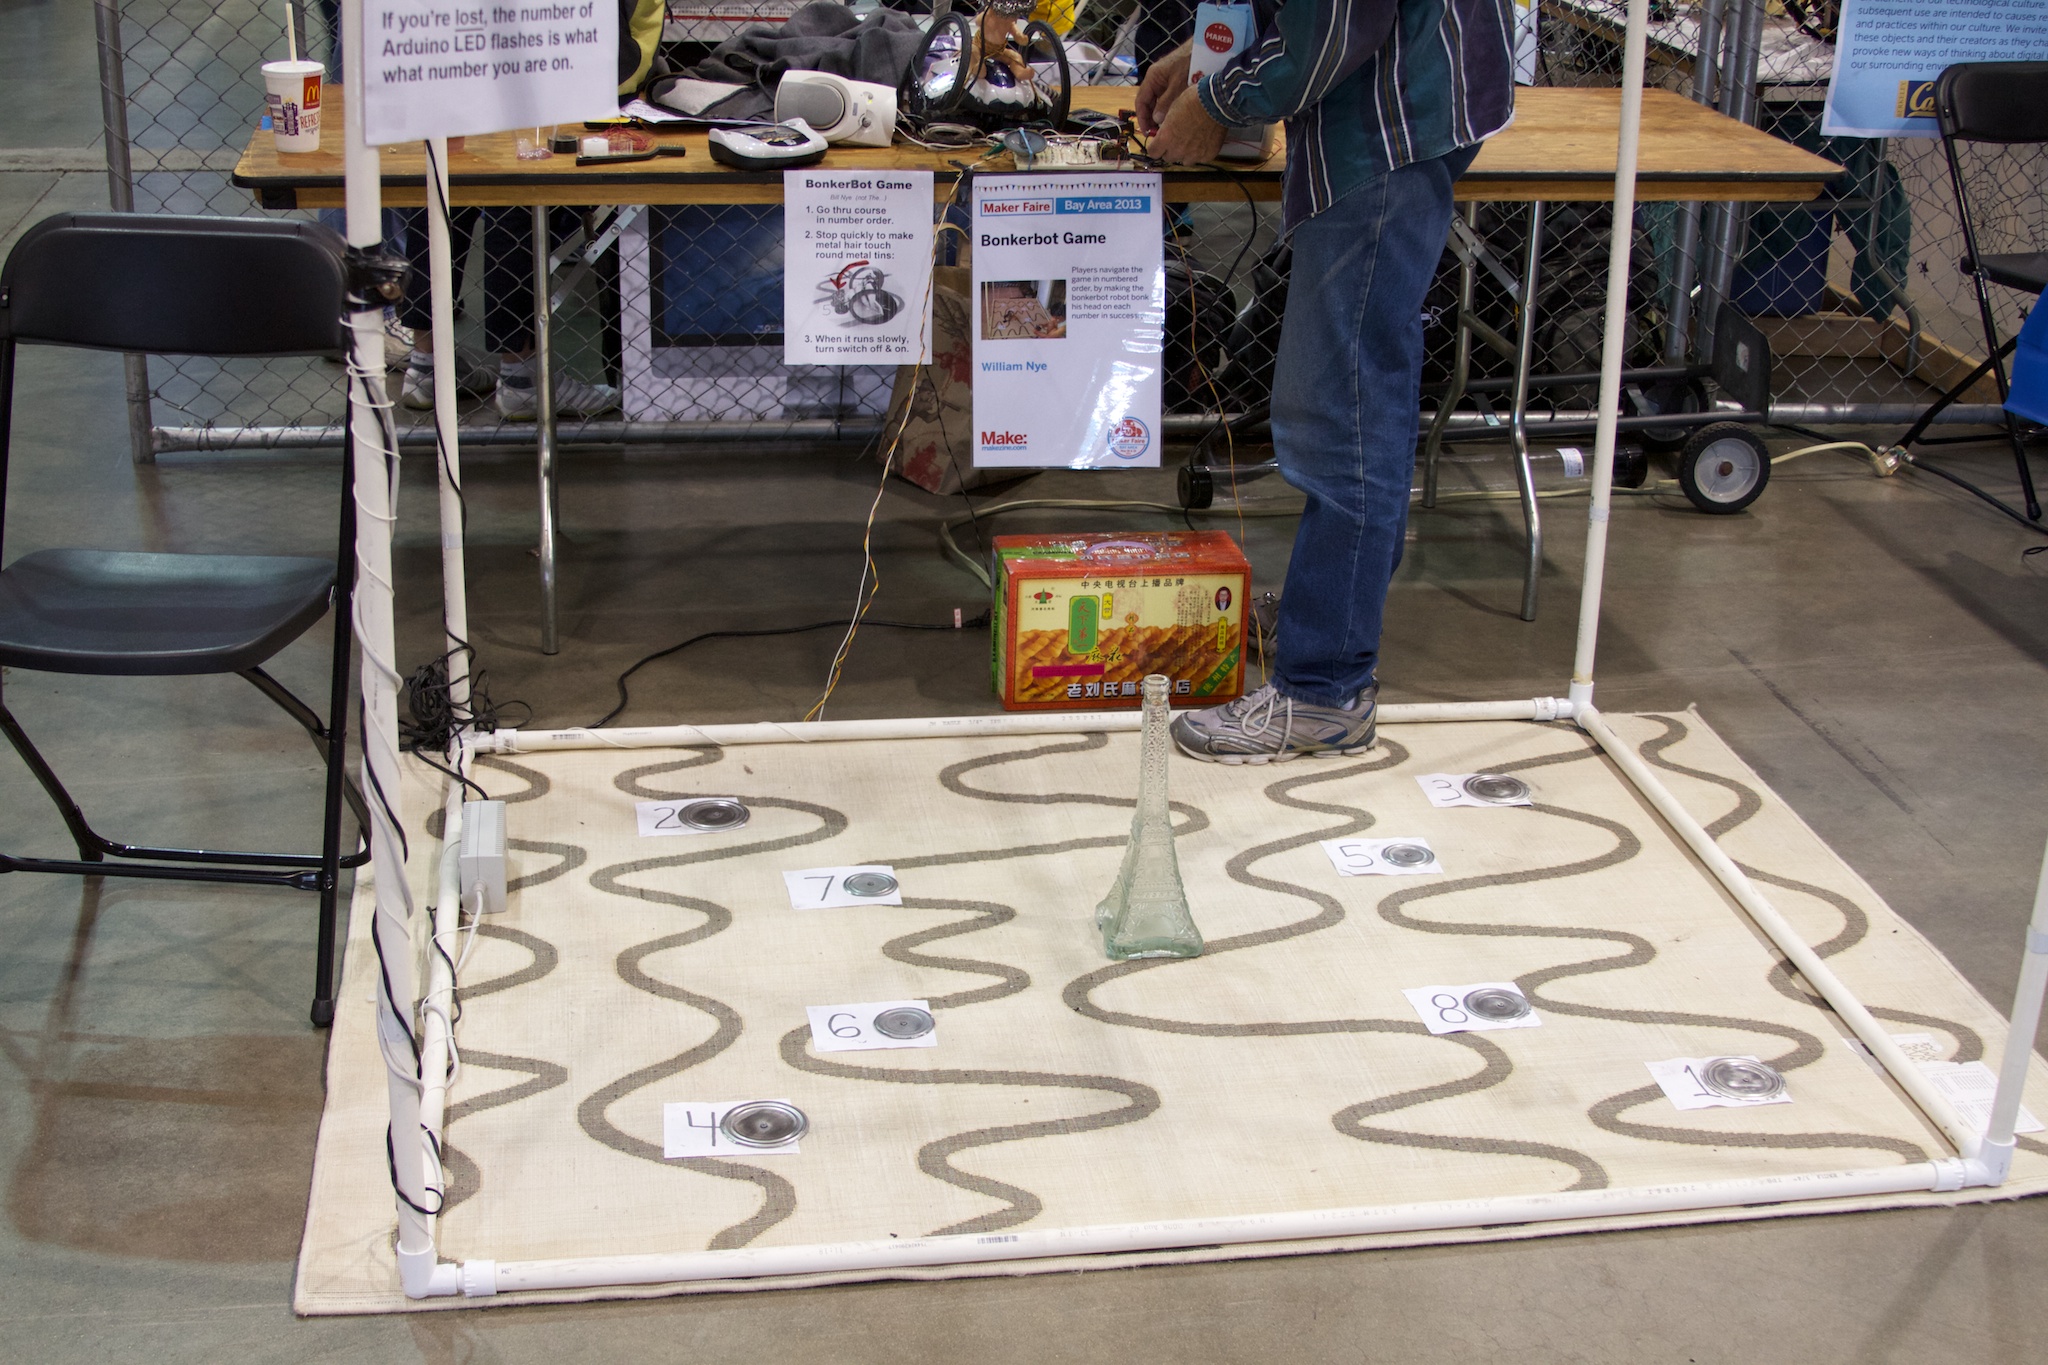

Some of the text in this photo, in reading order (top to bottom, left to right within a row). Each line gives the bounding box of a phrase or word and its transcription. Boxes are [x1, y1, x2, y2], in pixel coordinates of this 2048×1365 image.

[382, 2, 594, 34] If you're lost, the number of
[1858, 7, 1912, 17] subsequent
[1914, 9, 1930, 17] use
[1932, 10, 1947, 18] are
[1950, 9, 1990, 19] intended
[1993, 11, 2003, 20] to
[2005, 13, 2036, 21] causes
[1855, 20, 1873, 29] and
[1875, 20, 1917, 31] practices
[1920, 21, 1948, 31] within
[2006, 24, 2020, 33] We
[2022, 25, 2047, 34] invite
[382, 28, 598, 57] Arduino LED flashes is what
[1206, 32, 1233, 44] MAKER
[1854, 33, 1879, 43] these
[1881, 33, 1914, 45] objects
[1917, 34, 1935, 44] and
[1936, 34, 1958, 45] their
[1959, 36, 1997, 46] creators
[1998, 38, 2009, 46] as
[2011, 37, 2031, 49] they
[1852, 47, 1890, 58] provoke
[1913, 50, 1937, 59] ways
[1938, 48, 1950, 57] of
[1950, 48, 1987, 60] thinking
[1987, 49, 2015, 59] about
[2017, 50, 2045, 62] digital
[383, 56, 574, 84] what number you are on.
[1851, 61, 1867, 69] our
[1868, 60, 1924, 72] surrounding
[1908, 81, 1936, 114] Ca
[805, 179, 913, 190] BonkerBot Game
[806, 206, 887, 215] 1. Go thru course
[984, 199, 1142, 213] Maker Faire Bay Area 2013
[816, 216, 894, 225] in number order.
[805, 230, 914, 241] 2. Stop quickly to make
[981, 232, 1106, 247] Bonkerbot Game
[815, 241, 891, 250] metal hair touch
[815, 251, 895, 260] round metal tins:
[1071, 266, 1098, 275] Players
[1099, 266, 1130, 274] navigate
[1093, 285, 1103, 293] by
[805, 335, 813, 343] 3.
[815, 335, 842, 343] When
[844, 335, 851, 343] it
[877, 335, 910, 345] slowly,
[815, 345, 834, 353] turn
[837, 345, 868, 353] switch
[870, 345, 883, 353] off
[885, 345, 892, 353] &
[982, 362, 1047, 373] William Nye
[981, 431, 1027, 445] Make:
[1080, 578, 1185, 590] 中央电视台上播品牌
[1067, 679, 1191, 698] 老刘氏麻店
[1432, 779, 1462, 801] 3
[654, 807, 682, 829] 2
[1339, 844, 1374, 868] 5
[804, 875, 835, 901] 7
[1431, 993, 1468, 1023] 8
[828, 1013, 862, 1038] 6
[1684, 1064, 1722, 1098] 1
[686, 1111, 721, 1147] 4
